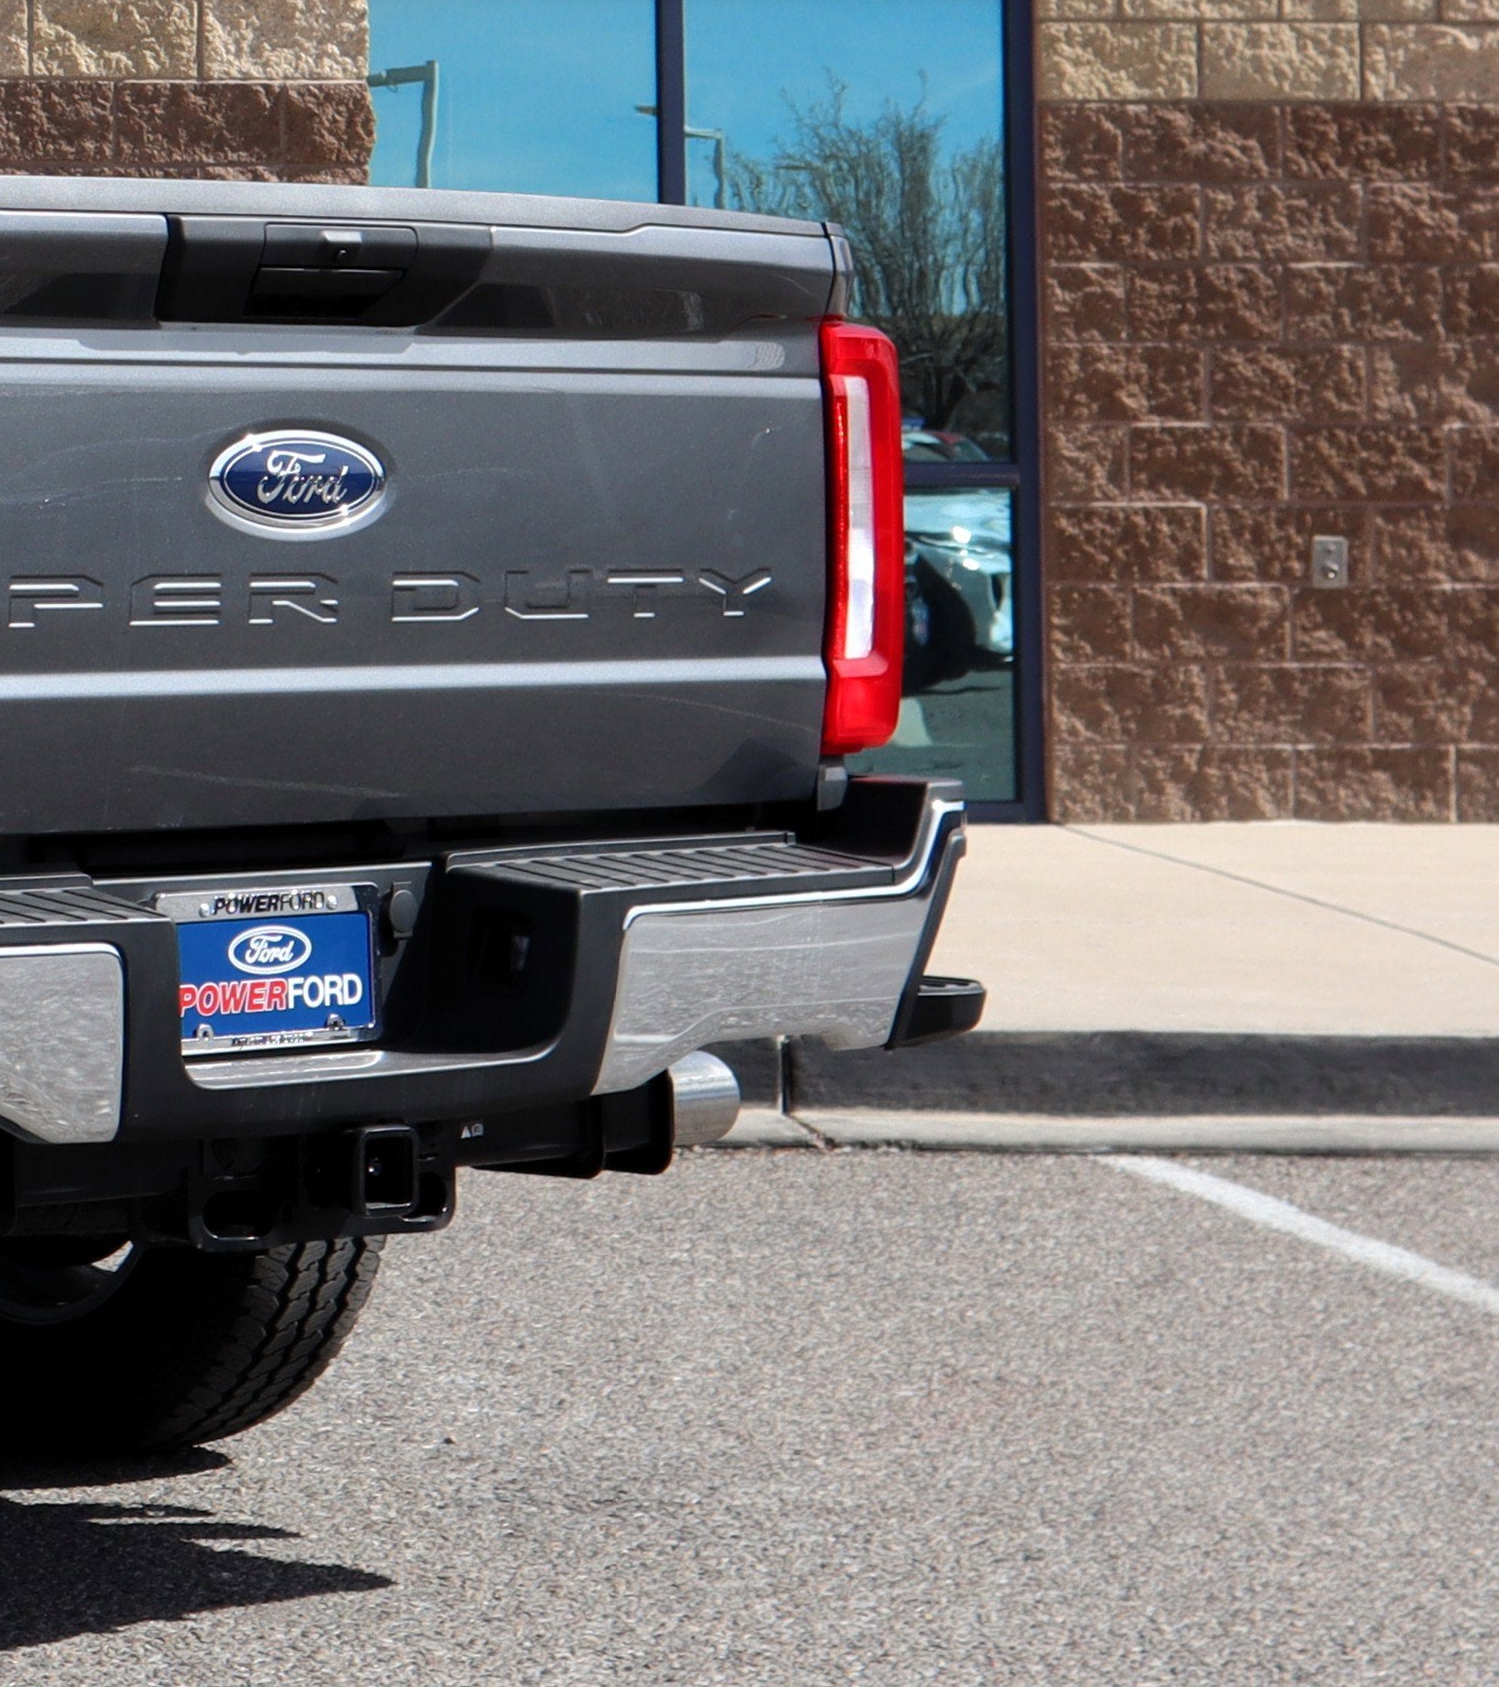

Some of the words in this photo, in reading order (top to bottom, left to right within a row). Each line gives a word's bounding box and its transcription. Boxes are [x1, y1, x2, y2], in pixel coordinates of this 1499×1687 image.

[257, 450, 349, 504] Ford
[391, 567, 773, 623] DUTY
[245, 936, 294, 963] Ford
